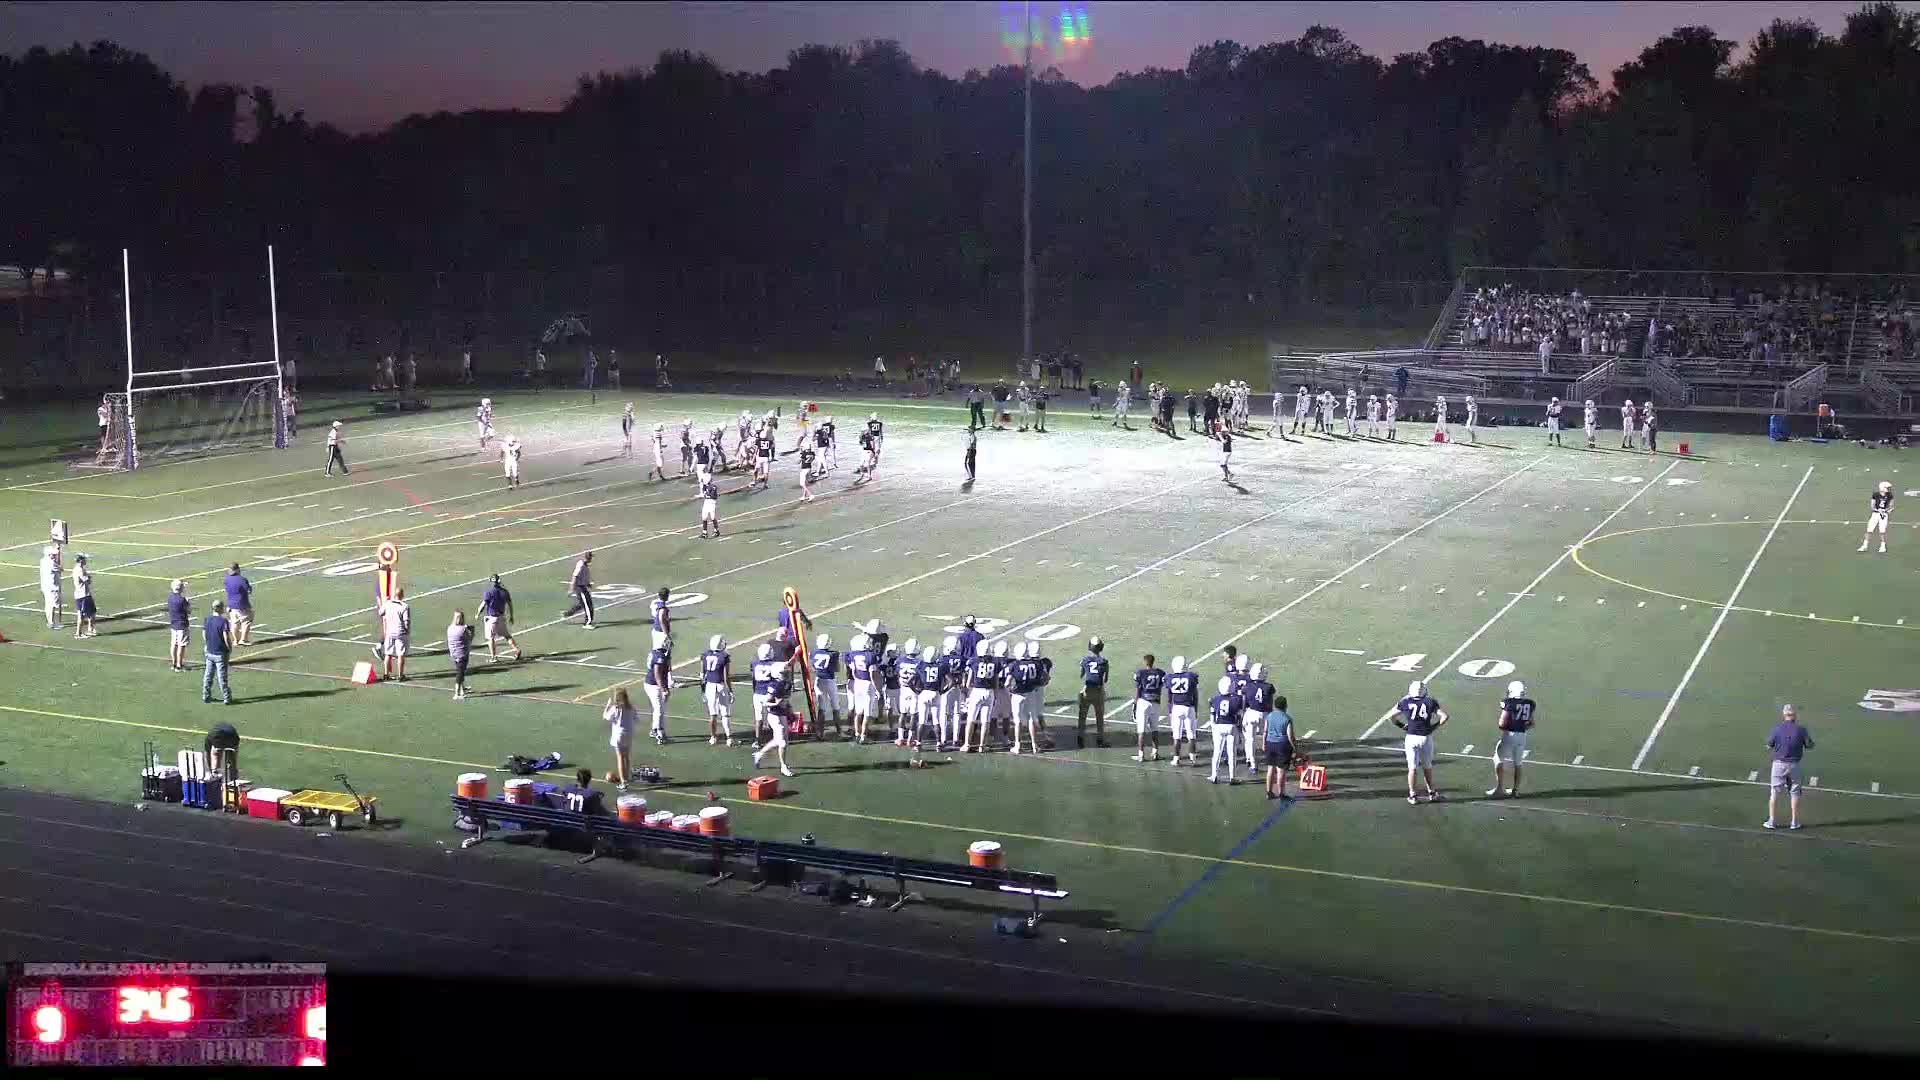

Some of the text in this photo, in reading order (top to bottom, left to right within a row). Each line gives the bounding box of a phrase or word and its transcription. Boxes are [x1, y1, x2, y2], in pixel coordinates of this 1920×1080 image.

[871, 423, 880, 431] 20
[760, 440, 770, 449] 50
[813, 653, 831, 670] 27
[1088, 661, 1099, 674] 2
[1366, 653, 1517, 678] 40
[977, 662, 996, 679] 88
[1019, 663, 1037, 681] 70
[1145, 675, 1160, 690] 21
[1171, 677, 1189, 694] 23
[1255, 687, 1263, 703] 4
[1219, 699, 1231, 717] 9
[1408, 703, 1429, 720] 74
[1515, 703, 1531, 720] 79
[1302, 768, 1323, 788] 40
[567, 792, 584, 813] 77
